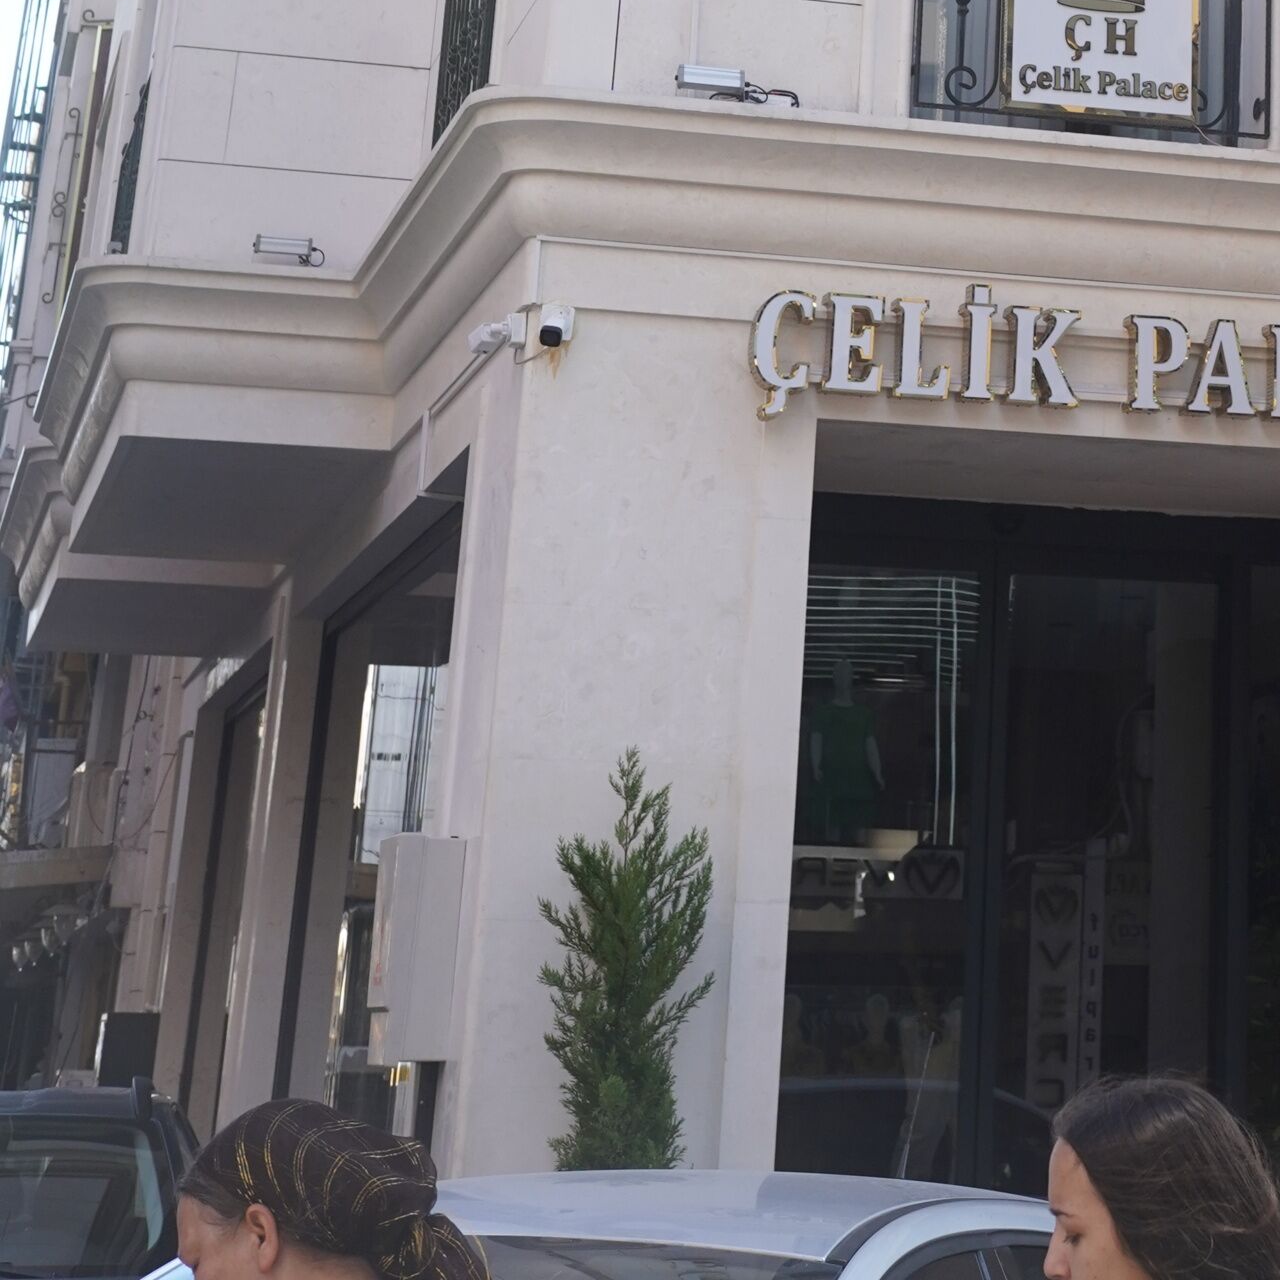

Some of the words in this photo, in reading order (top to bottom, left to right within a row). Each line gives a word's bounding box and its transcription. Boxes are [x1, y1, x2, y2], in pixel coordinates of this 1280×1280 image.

[1019, 64, 1091, 94] Çelik
[1097, 70, 1189, 101] Palace
[750, 284, 1081, 421] ÇELİK
